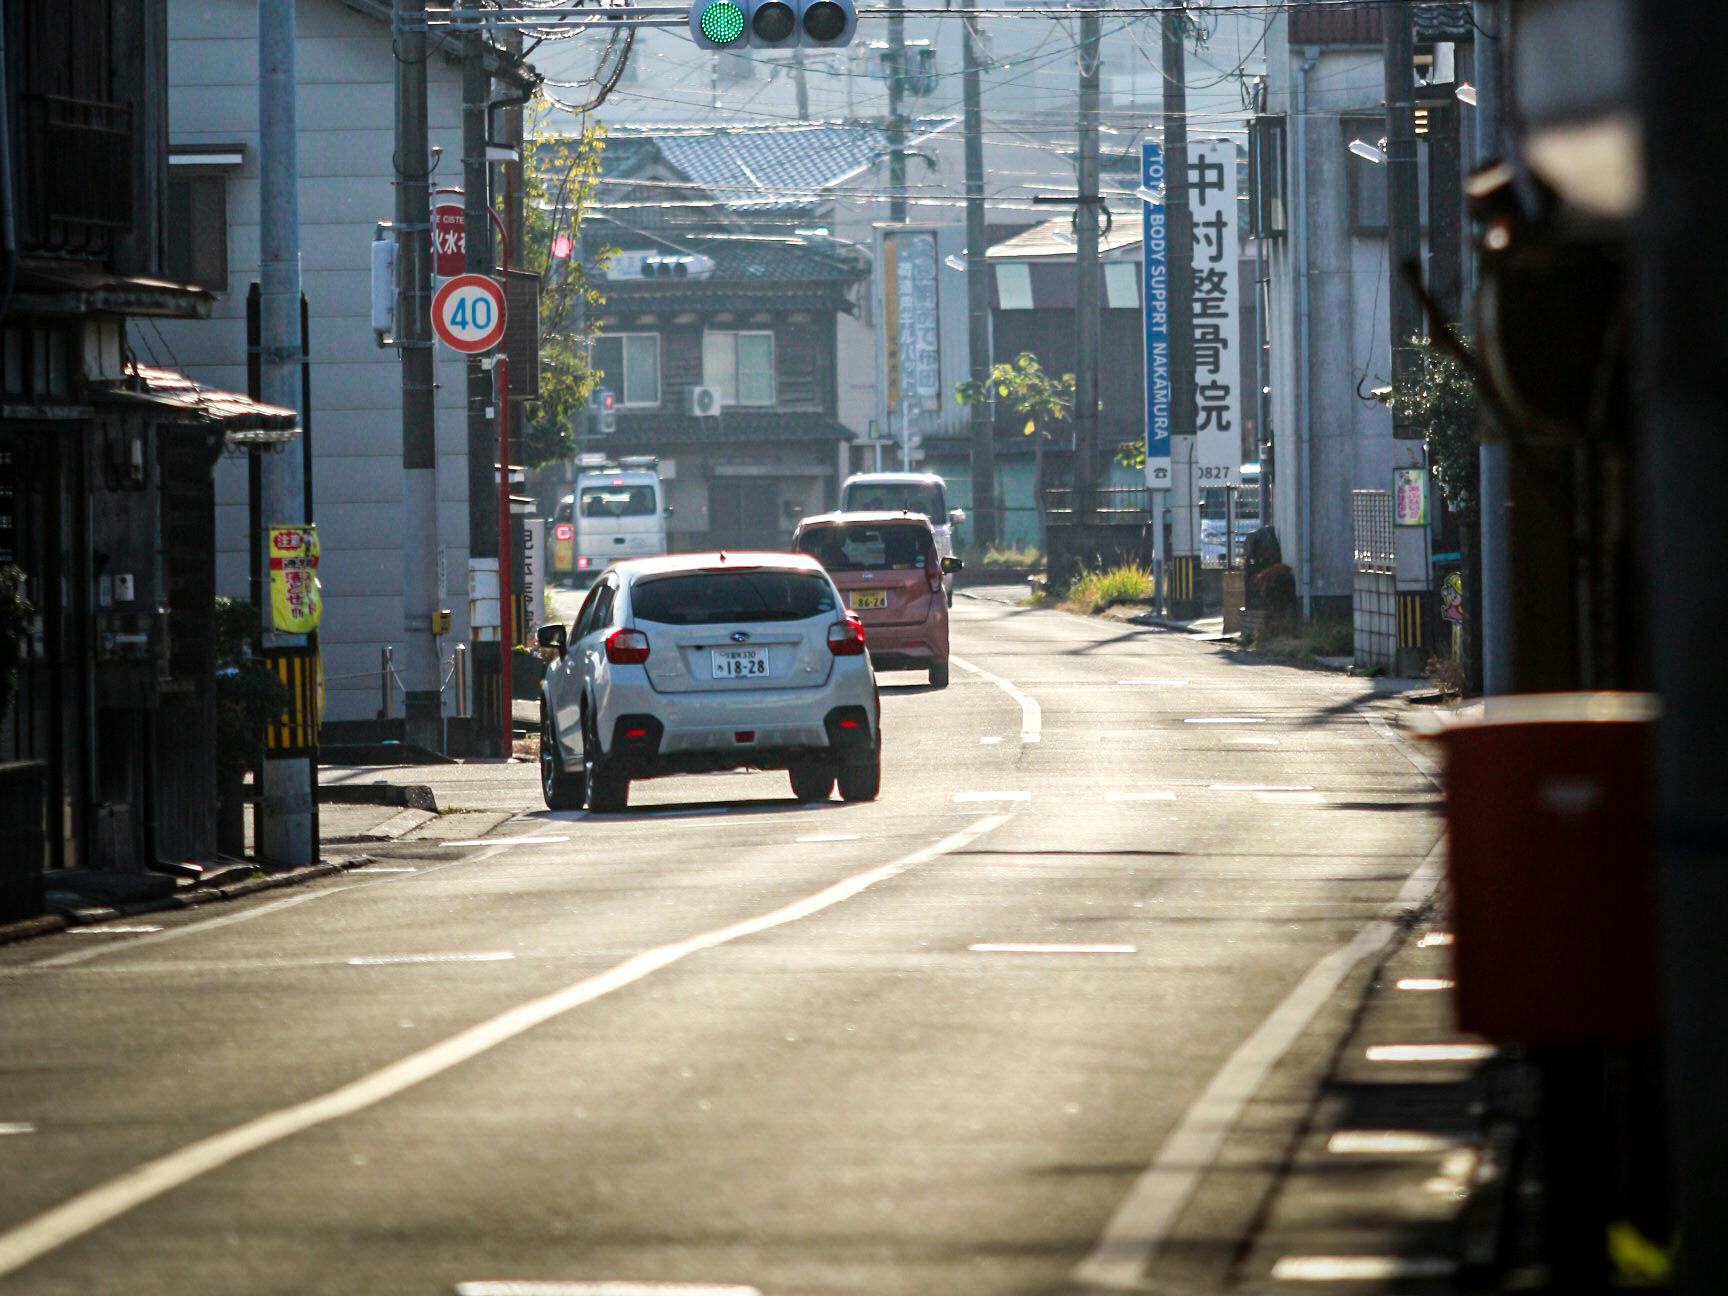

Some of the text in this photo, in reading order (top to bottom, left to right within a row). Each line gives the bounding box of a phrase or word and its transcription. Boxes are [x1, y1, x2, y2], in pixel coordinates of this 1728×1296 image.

[442, 215, 466, 224] CISTE
[1150, 214, 1166, 262] BODY
[450, 296, 492, 331] 40
[1151, 265, 1167, 335] SUPPRT
[1152, 342, 1169, 441] NAKAMURA
[727, 659, 765, 675] 18-28
